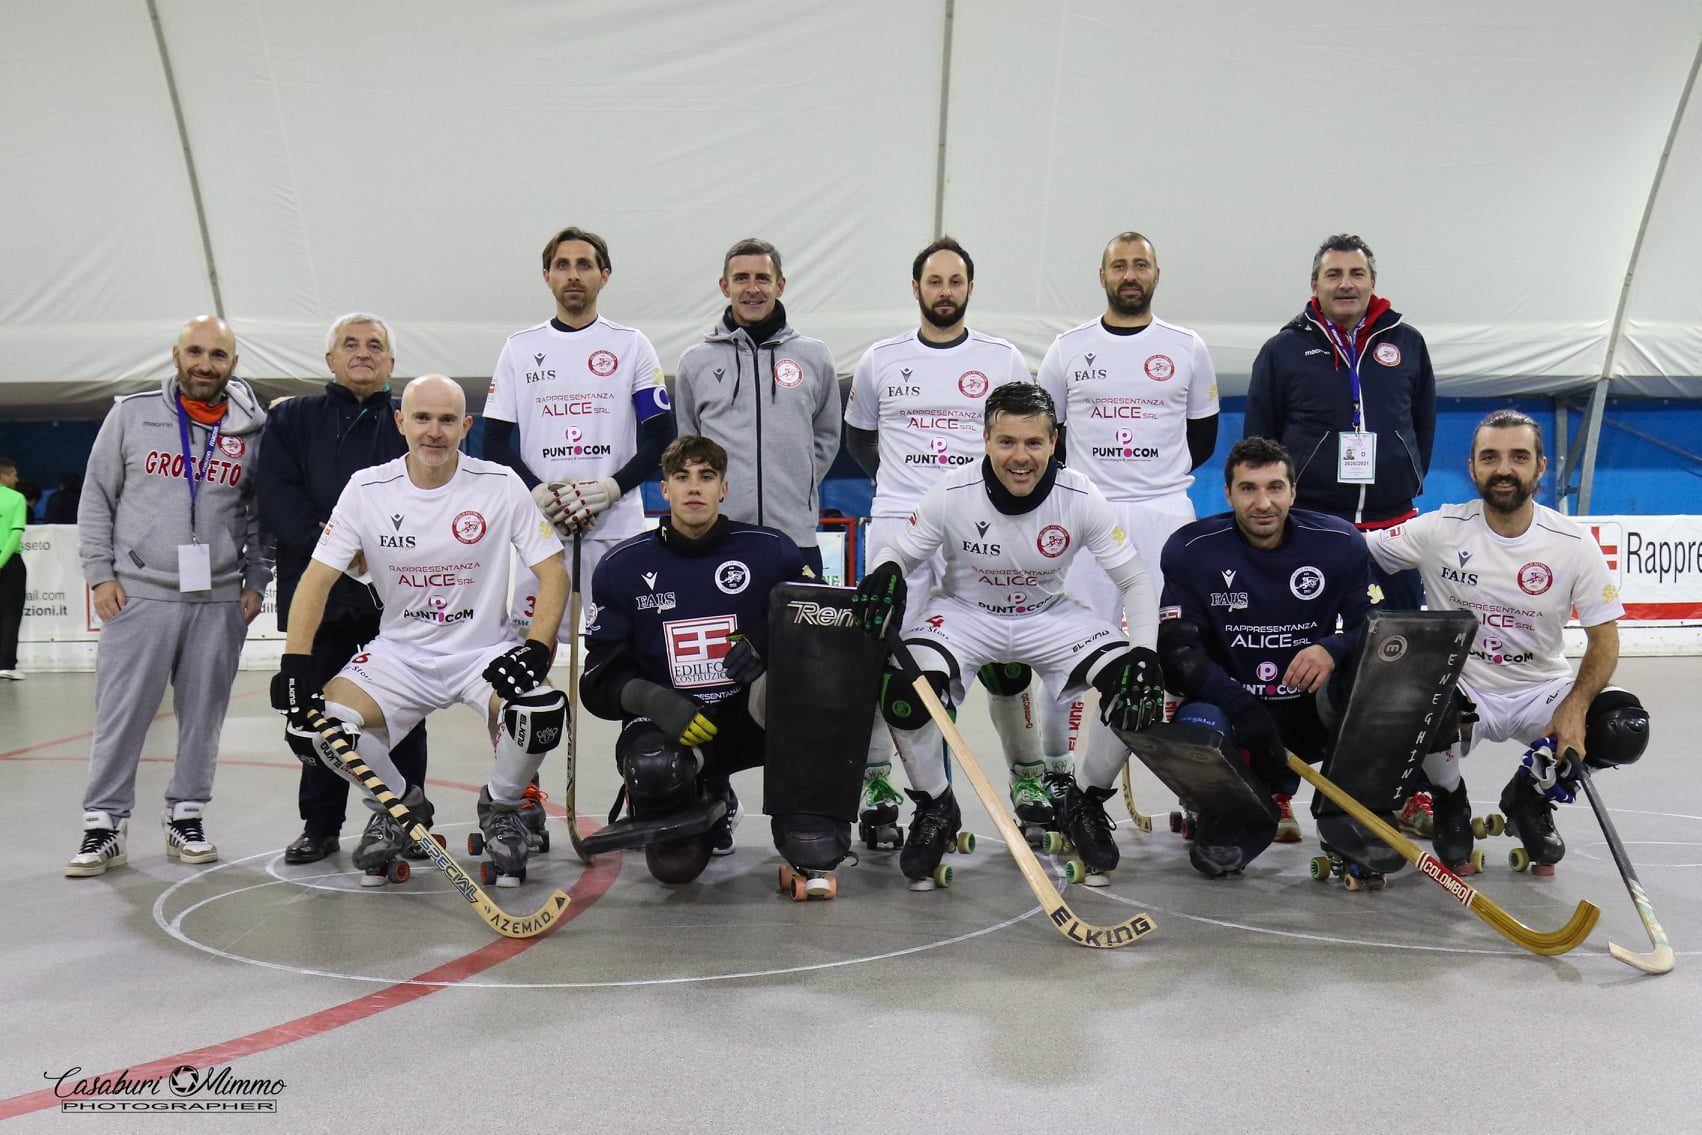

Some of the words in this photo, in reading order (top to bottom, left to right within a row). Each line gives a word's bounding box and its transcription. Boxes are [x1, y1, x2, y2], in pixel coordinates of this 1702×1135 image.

[526, 370, 557, 384] FAIS
[1074, 369, 1108, 382] FAIS
[535, 392, 615, 403] RAPPRESENTANZA
[888, 386, 921, 397] FAIS
[1084, 397, 1165, 406] RAPPRESENTANZA
[541, 401, 593, 418] ALICE
[899, 410, 983, 419] RAPPRESENTANZA
[1090, 406, 1142, 419] ALICE
[906, 417, 959, 430] ALICE
[379, 535, 417, 549] FAIS
[962, 541, 1001, 557] FAIS
[388, 561, 481, 573] RAPPRESENTANZA
[398, 573, 456, 588] ALICE
[978, 575, 1038, 587] ALICE
[1441, 566, 1479, 587] FAIS
[1449, 595, 1543, 618] RAPPRESENTANZA
[1225, 621, 1318, 633] RAPPRESENTANZA
[1072, 629, 1111, 654] ELKING
[1231, 633, 1292, 649] ALICE
[1293, 637, 1312, 647] SRL
[674, 662, 728, 677] EDILFO
[517, 713, 528, 748] ELKING
[418, 836, 479, 904] SPECIAL
[1422, 860, 1468, 900] COLOMBO
[1050, 905, 1152, 947] ELKING
